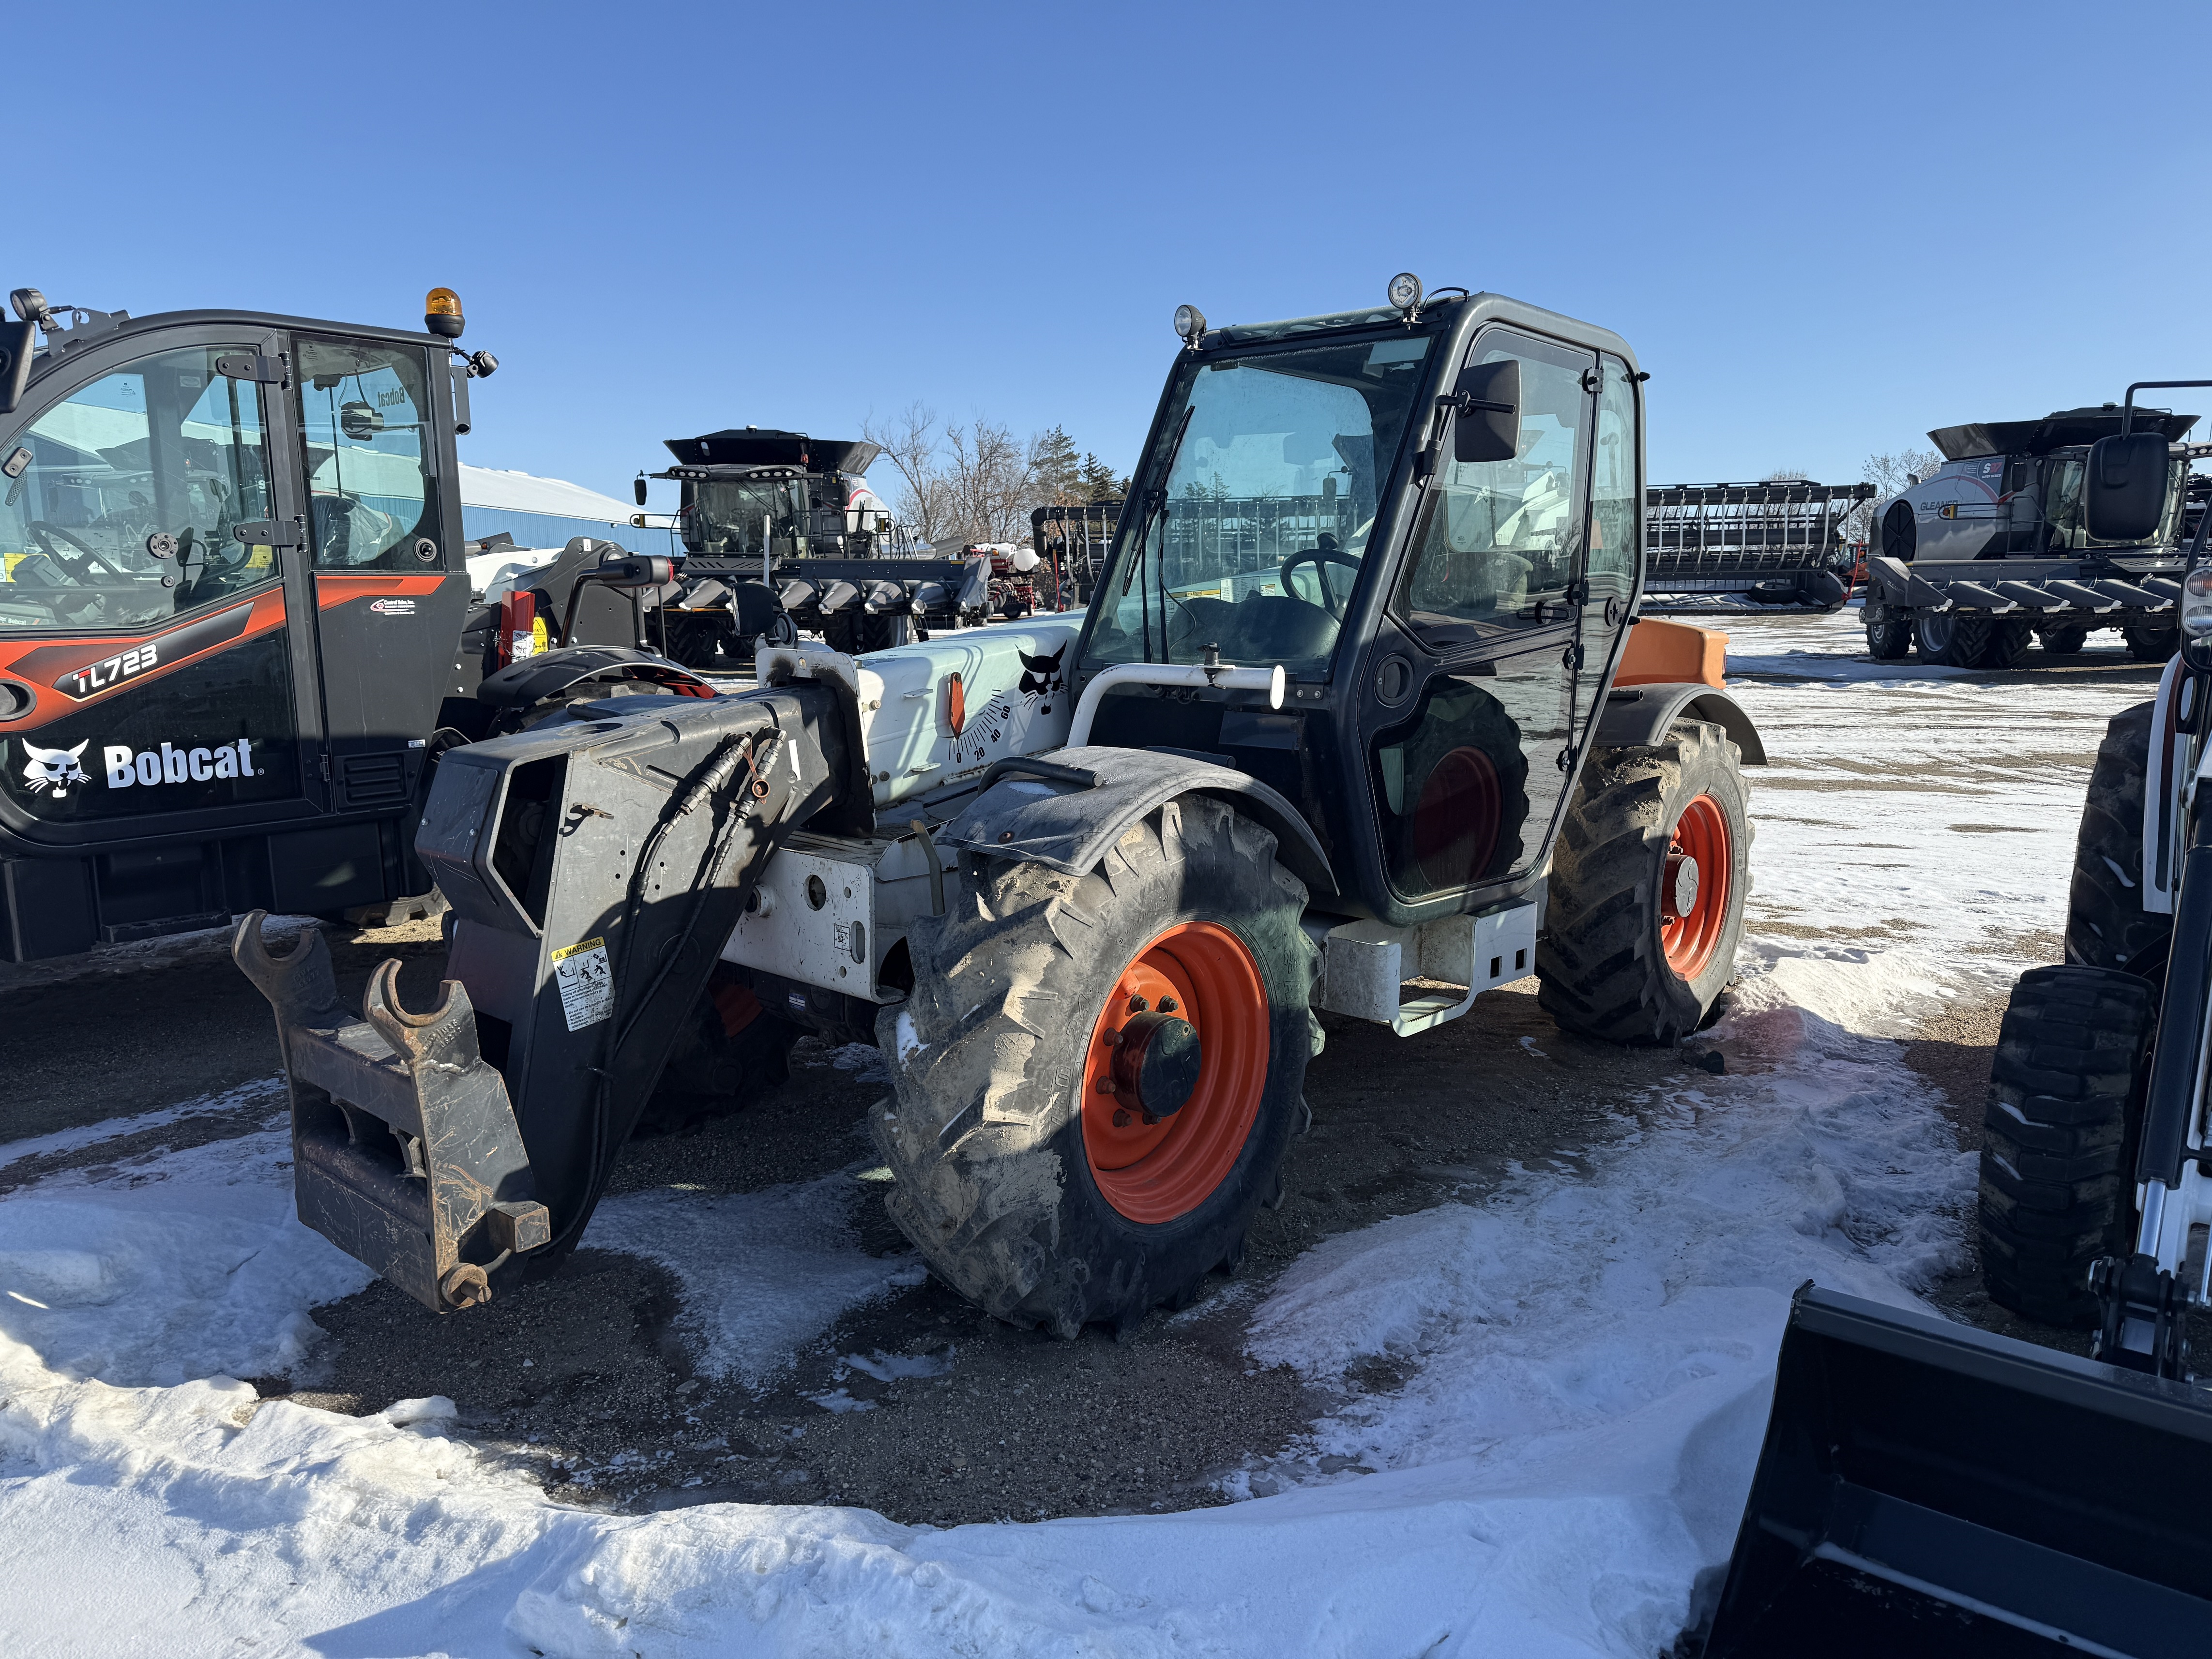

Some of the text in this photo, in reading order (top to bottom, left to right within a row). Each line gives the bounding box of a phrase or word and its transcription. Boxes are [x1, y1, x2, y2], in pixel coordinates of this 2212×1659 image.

[73, 643, 158, 694] TL723
[1000, 705, 1011, 720] 60
[990, 728, 1001, 743] 40
[956, 752, 962, 763] 0
[974, 746, 985, 761] 20
[104, 738, 254, 789] Bobcat
[564, 939, 601, 956] WARNING
